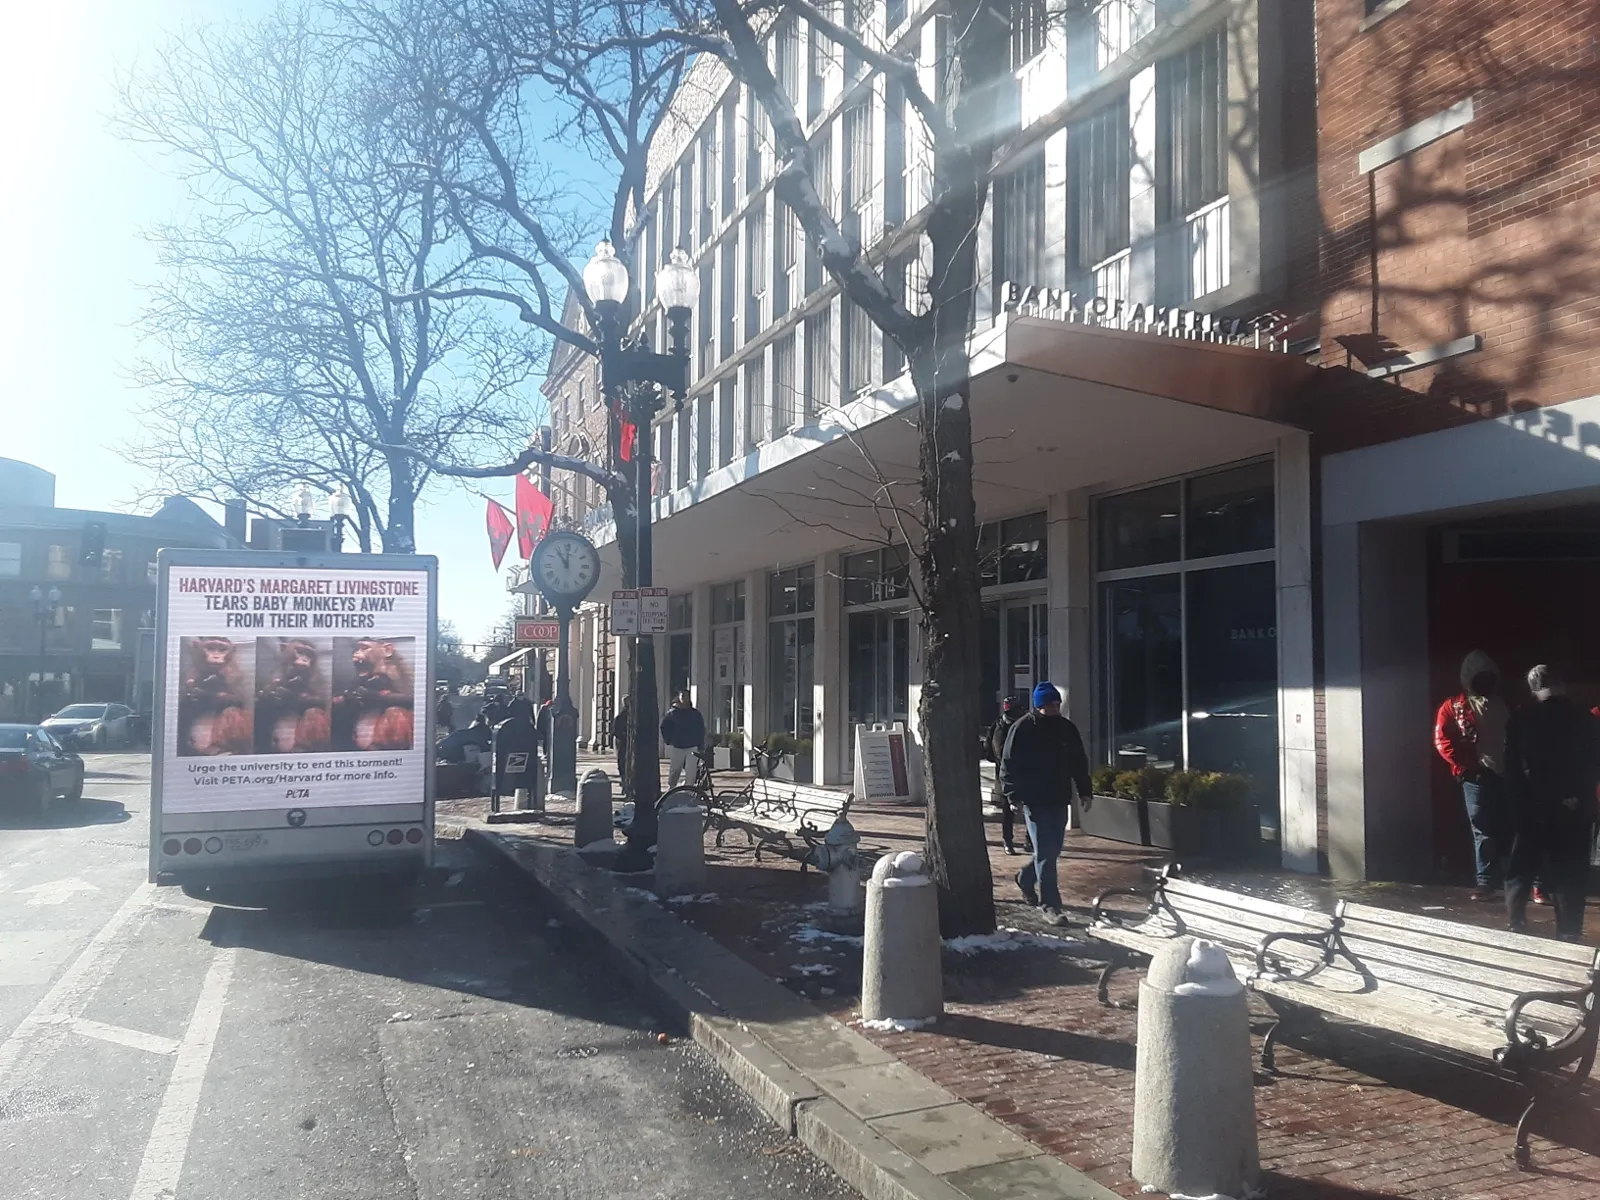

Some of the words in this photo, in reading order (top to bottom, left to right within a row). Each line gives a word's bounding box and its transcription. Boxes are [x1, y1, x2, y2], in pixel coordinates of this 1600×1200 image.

[179, 578, 255, 594] HARVARD'S
[260, 579, 332, 595] MARGARET
[336, 580, 419, 596] LIVINGSTONE
[205, 596, 248, 611] TEARS
[253, 596, 288, 611] BABY
[293, 597, 357, 612] MONKEYS
[360, 598, 395, 612] AWAY
[227, 613, 264, 628] FROM
[270, 614, 307, 628] THEIR
[313, 614, 375, 628] MOTHERS
[524, 625, 558, 638] COOP
[1230, 627, 1265, 640] BANK
[188, 764, 216, 774] Urge
[219, 764, 237, 772] the
[240, 762, 294, 772] university
[297, 762, 309, 770] to
[312, 760, 332, 769] end
[335, 759, 355, 768] this
[358, 758, 403, 767] torment!
[193, 776, 219, 785] Visit
[222, 773, 322, 785] PETA.org/Harvard
[326, 773, 341, 781] for
[374, 771, 398, 779] info.
